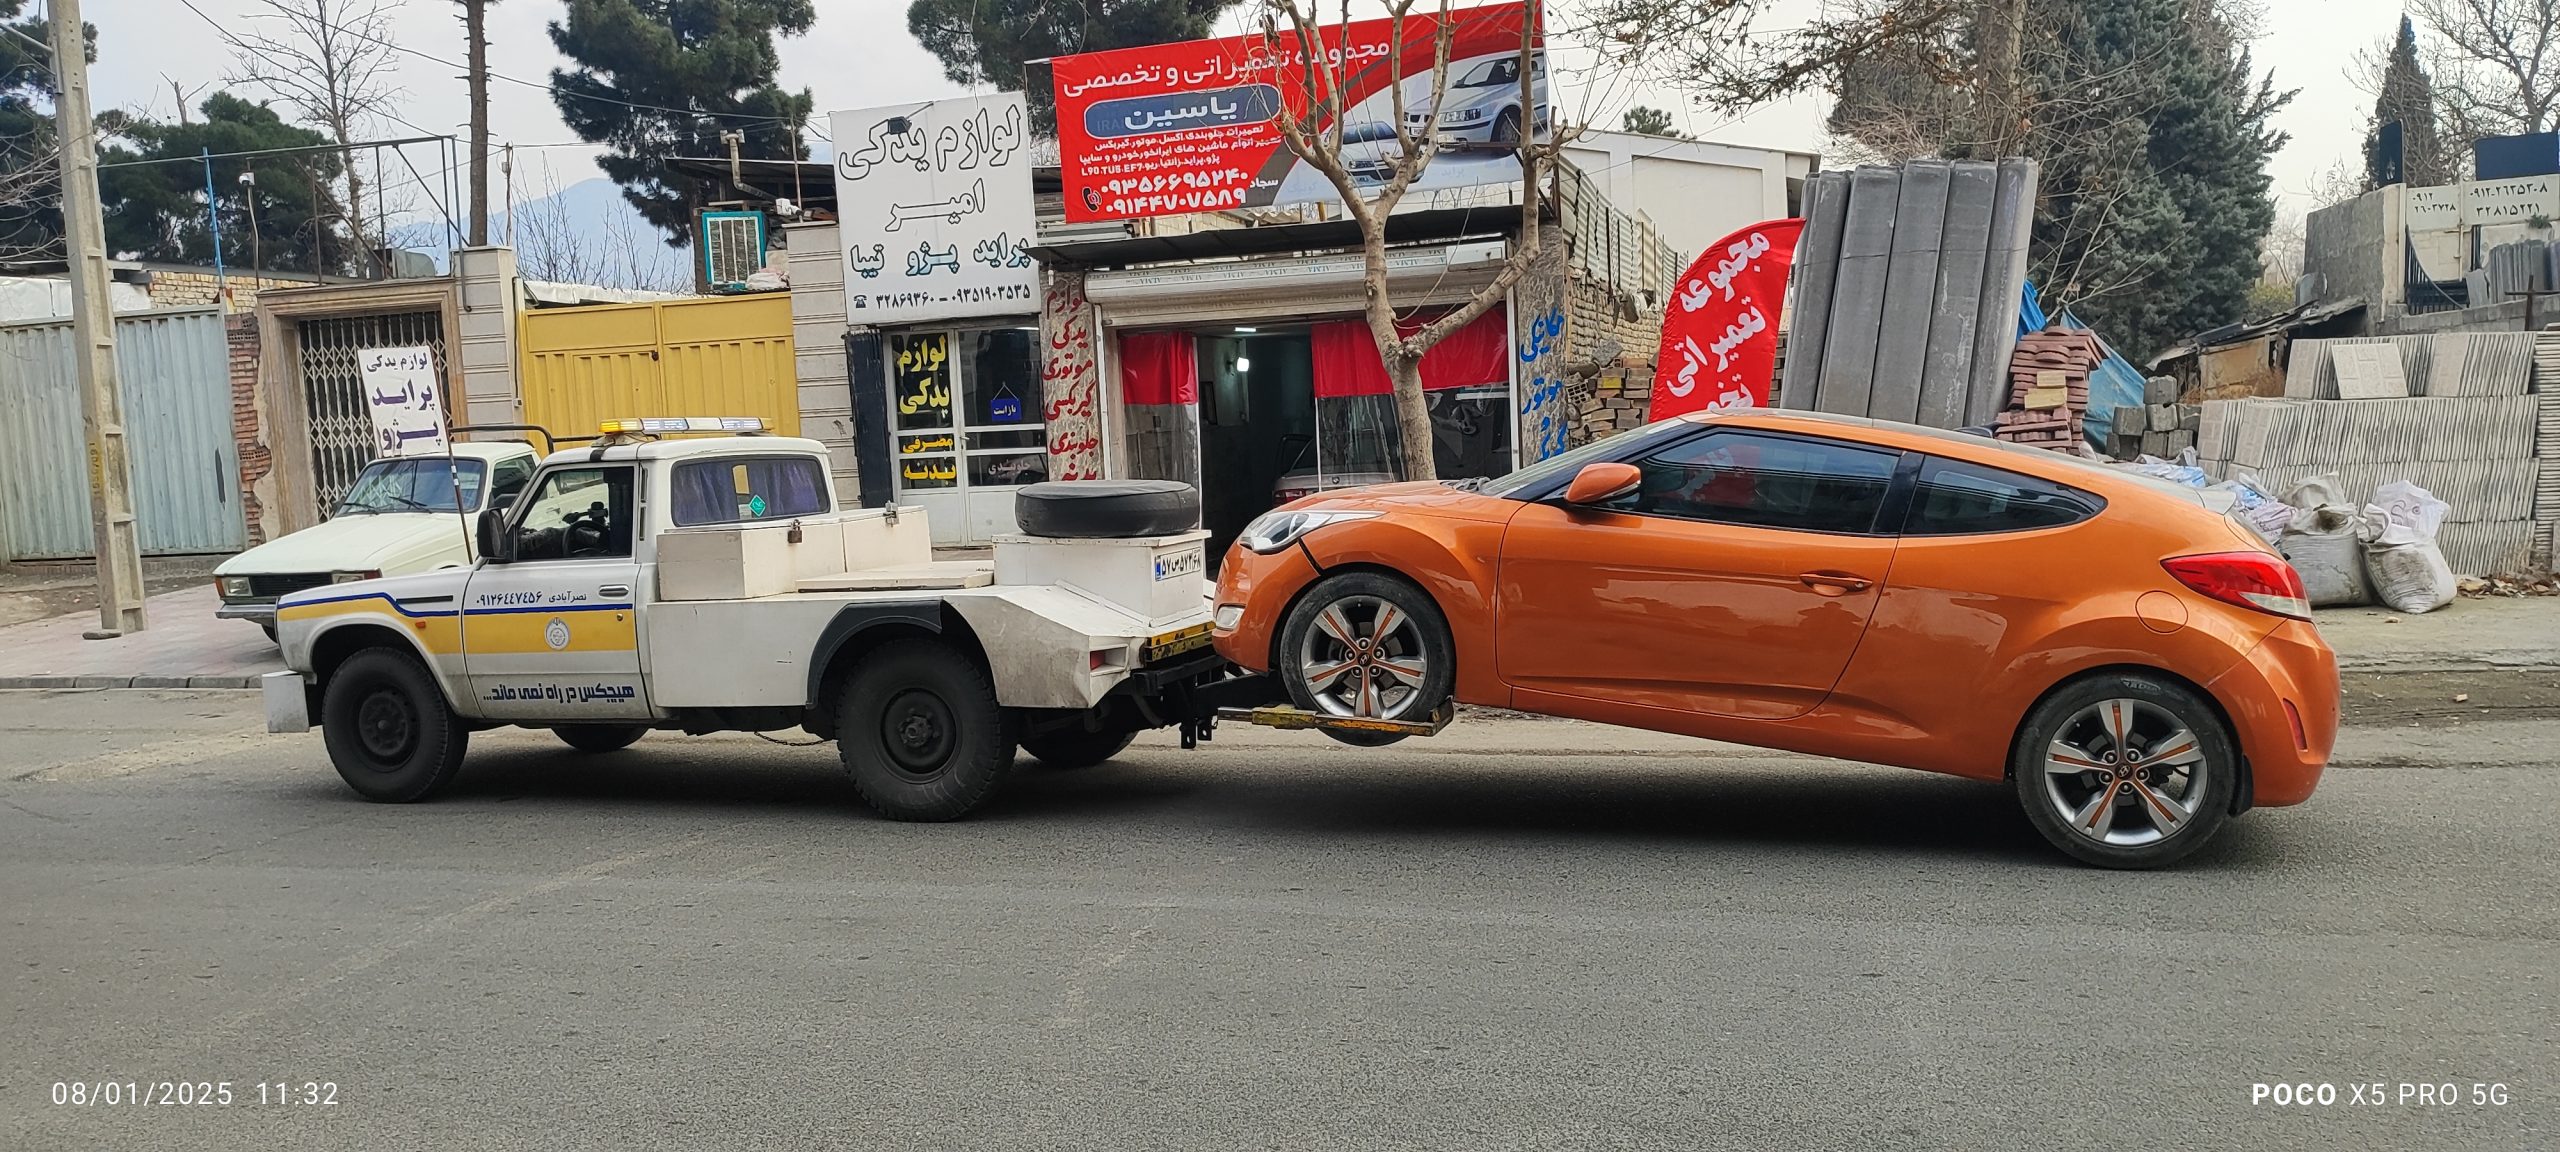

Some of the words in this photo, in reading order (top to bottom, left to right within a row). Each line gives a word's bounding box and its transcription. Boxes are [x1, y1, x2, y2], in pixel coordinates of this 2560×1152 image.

[1063, 63, 1161, 97] تخصصی
[1165, 66, 1179, 87] و
[1124, 96, 1238, 130] یاسین
[839, 118, 930, 180] یدکی
[935, 104, 1021, 172] لوازم
[1101, 168, 1248, 195] ۰۹۳۵۶۶۹۵۲۴۰
[884, 178, 985, 232] امیر
[1105, 188, 1246, 214] ۰۹۱۴۴۷۰۷۵۸۹
[906, 241, 960, 276] پژو
[973, 232, 1031, 268] پراید
[1052, 315, 1088, 349] یدکی
[366, 354, 396, 372] یدکی
[400, 352, 428, 371] لوازم
[899, 334, 946, 377] لوازم
[1042, 353, 1093, 380] موتوری
[372, 378, 435, 411] پراید
[900, 377, 950, 418] یدکی
[1521, 377, 1563, 415] موتور
[382, 418, 442, 450] پژو
[903, 435, 954, 454] مصرفی
[904, 462, 957, 486] بدنه
[546, 684, 564, 703] راه
